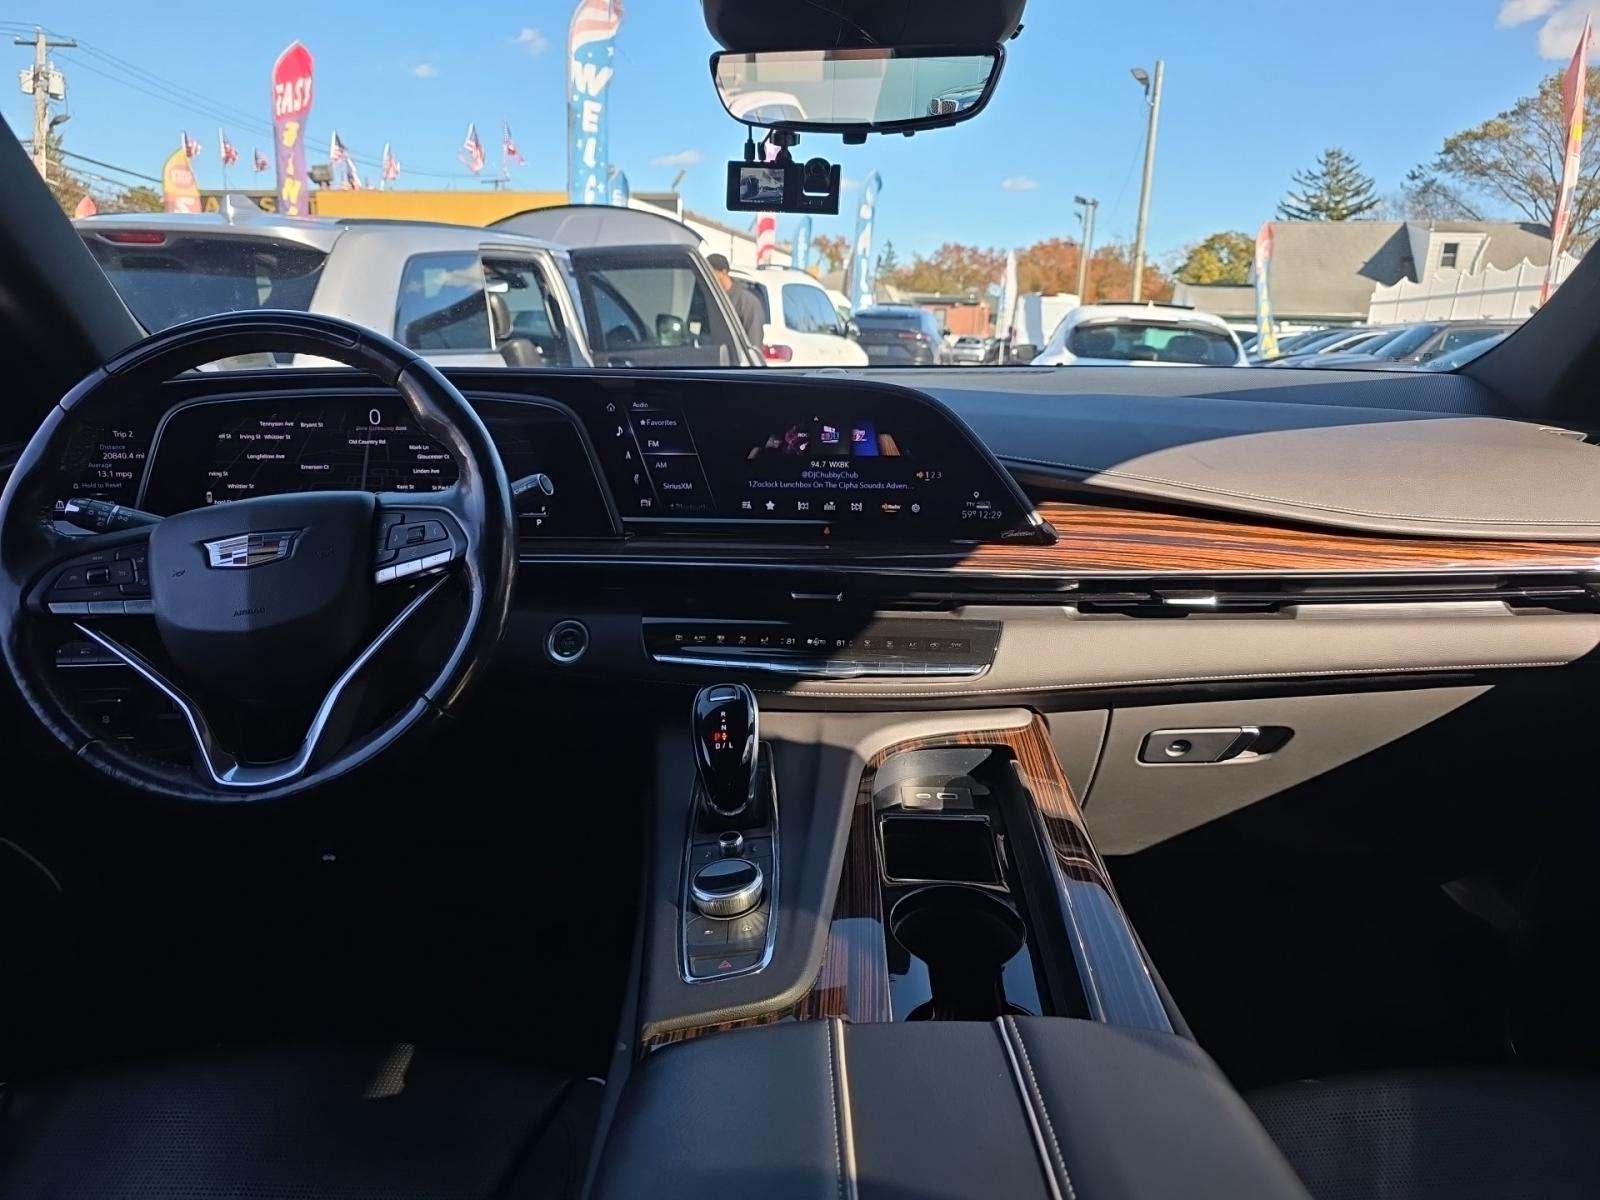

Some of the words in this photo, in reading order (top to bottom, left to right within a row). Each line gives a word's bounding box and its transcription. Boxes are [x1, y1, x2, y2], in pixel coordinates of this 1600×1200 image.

[369, 409, 381, 425] 0
[111, 430, 127, 439] Trip
[128, 430, 134, 438] 2
[102, 452, 134, 460] 20840.4
[655, 461, 668, 469] AM
[810, 461, 826, 469] 94.7
[97, 470, 113, 478] 13.1
[115, 471, 133, 479] mpg
[663, 482, 693, 490] SiriusXM
[779, 481, 812, 489] Lunchbox
[812, 481, 825, 489] On
[825, 481, 838, 489] The
[859, 482, 885, 490] Sounds
[979, 510, 1002, 519] 12:29
[536, 518, 543, 526] P
